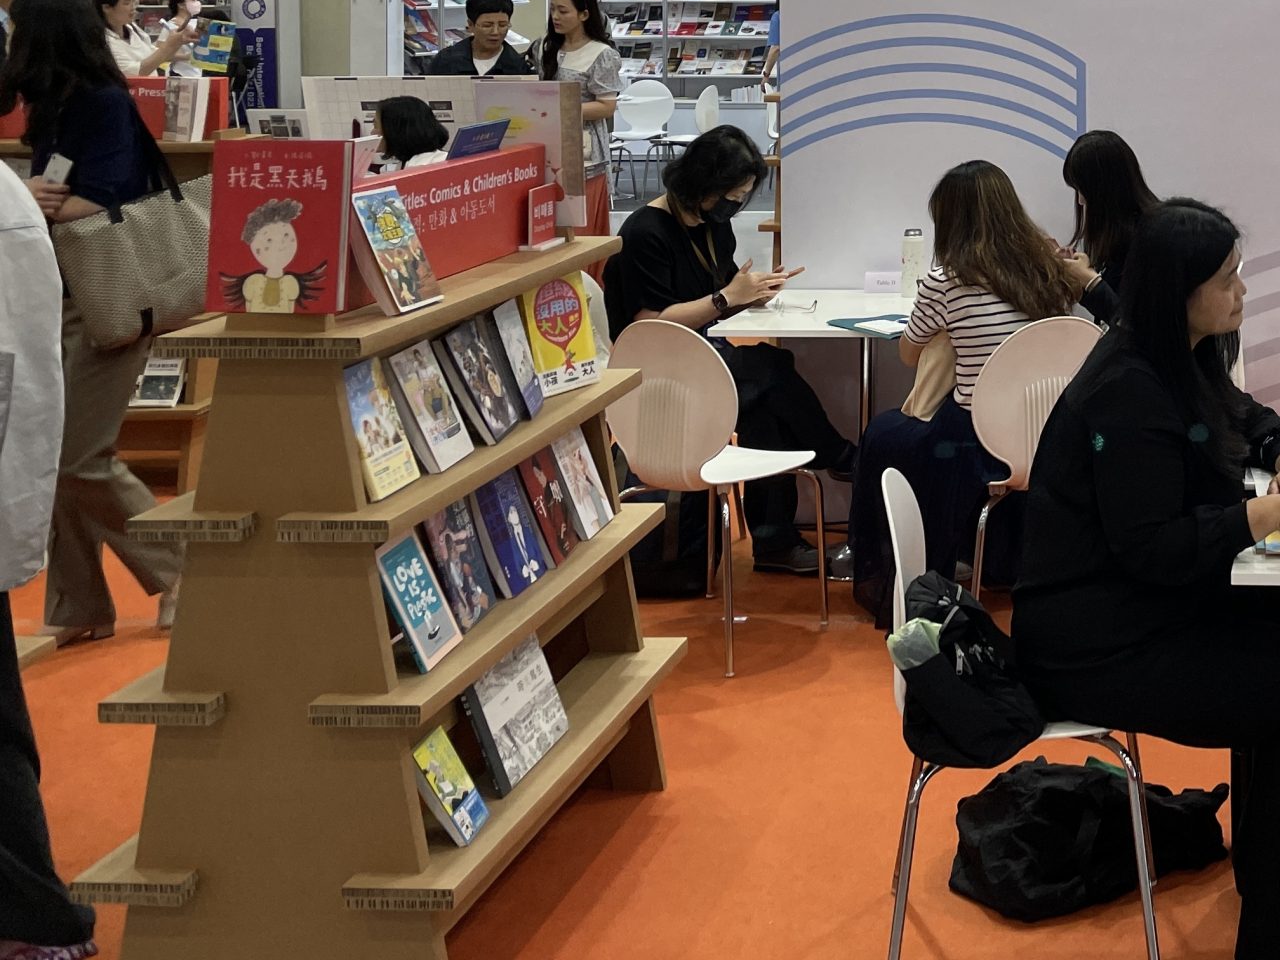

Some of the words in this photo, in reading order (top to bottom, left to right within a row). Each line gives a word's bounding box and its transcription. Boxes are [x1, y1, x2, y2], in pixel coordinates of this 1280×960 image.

[138, 87, 167, 98] Press
[227, 162, 328, 191] 我是黑天鵝
[429, 184, 461, 204] Comics
[463, 179, 471, 194] &
[472, 170, 512, 193] Children's
[514, 162, 538, 182] Books
[428, 207, 448, 230] 만화
[450, 208, 457, 225] &
[460, 193, 496, 221] 아동도서
[393, 558, 423, 590] LOVE
